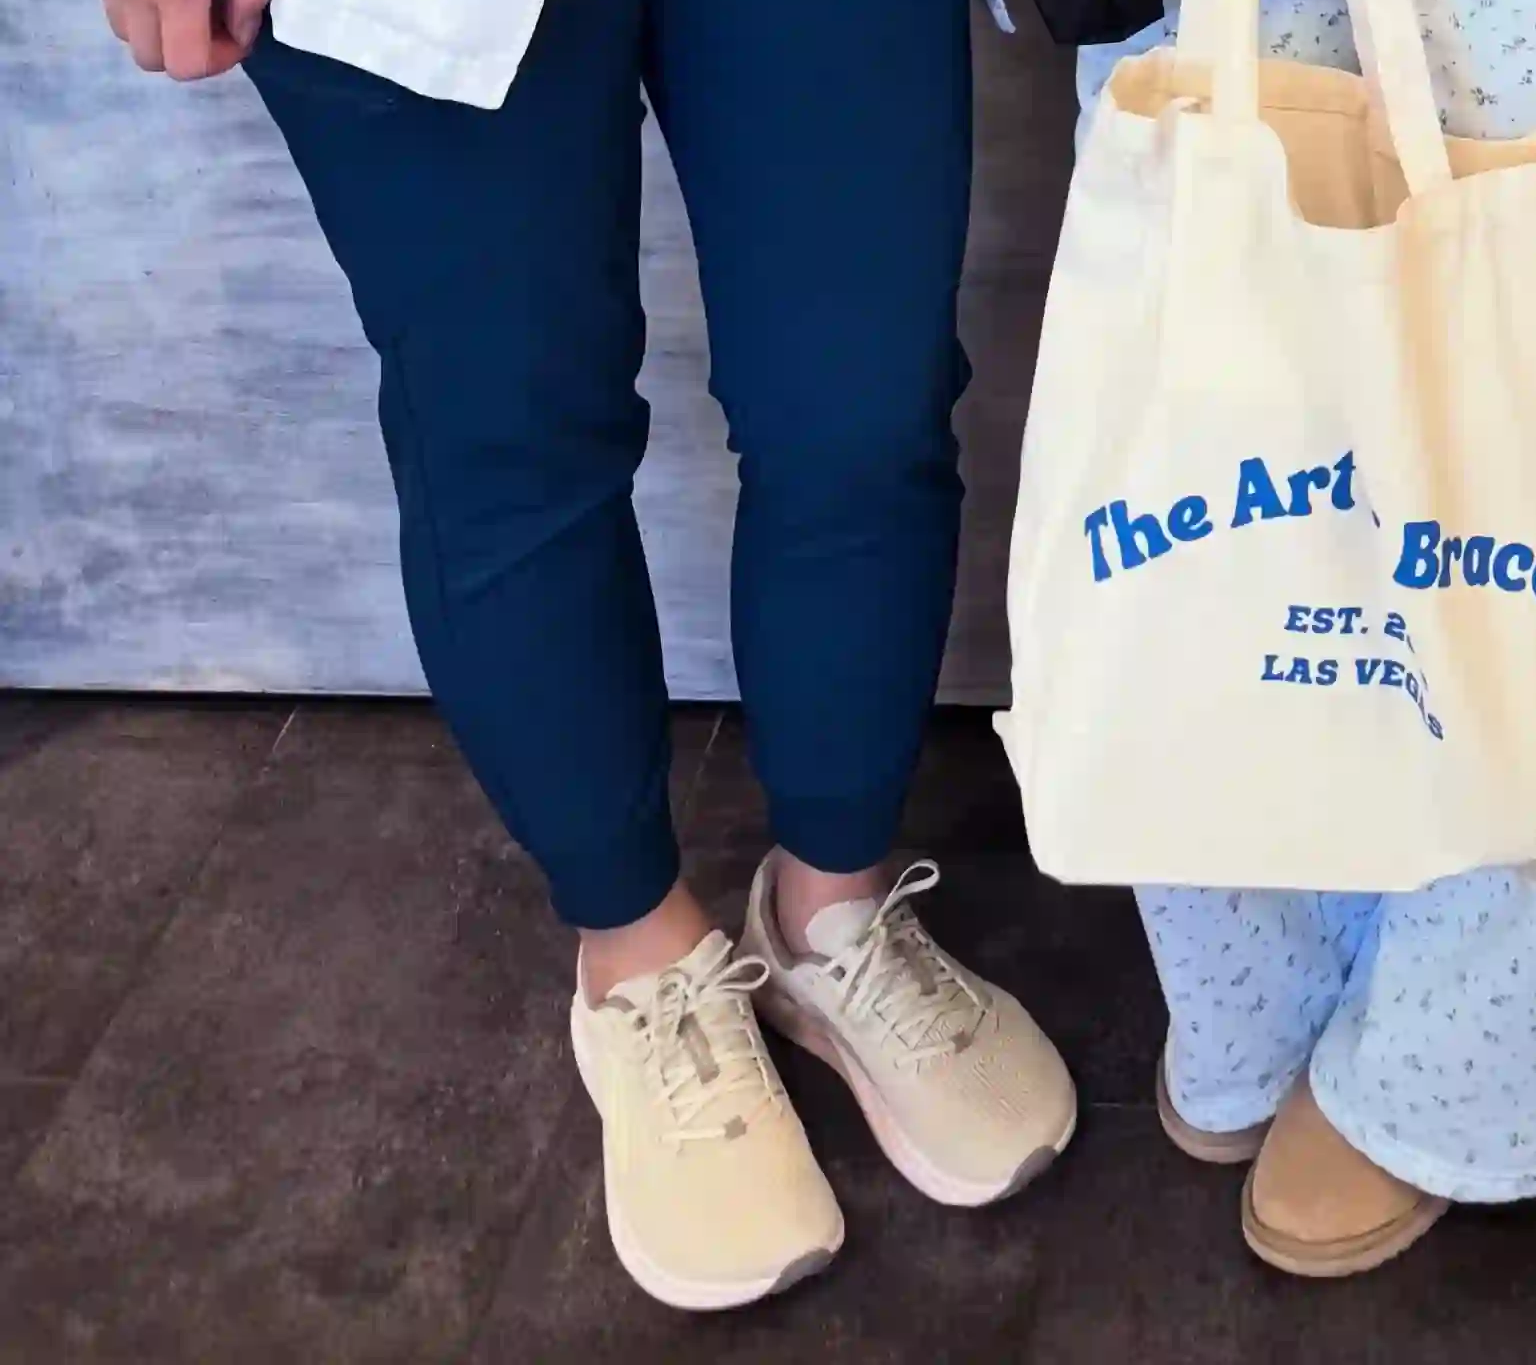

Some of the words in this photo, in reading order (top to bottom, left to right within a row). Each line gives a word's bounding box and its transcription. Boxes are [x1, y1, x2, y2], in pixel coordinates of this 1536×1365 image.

[1084, 494, 1214, 583] The
[1230, 449, 1357, 530] Art
[1284, 604, 1369, 637] EST.
[1260, 654, 1339, 687] LAS
